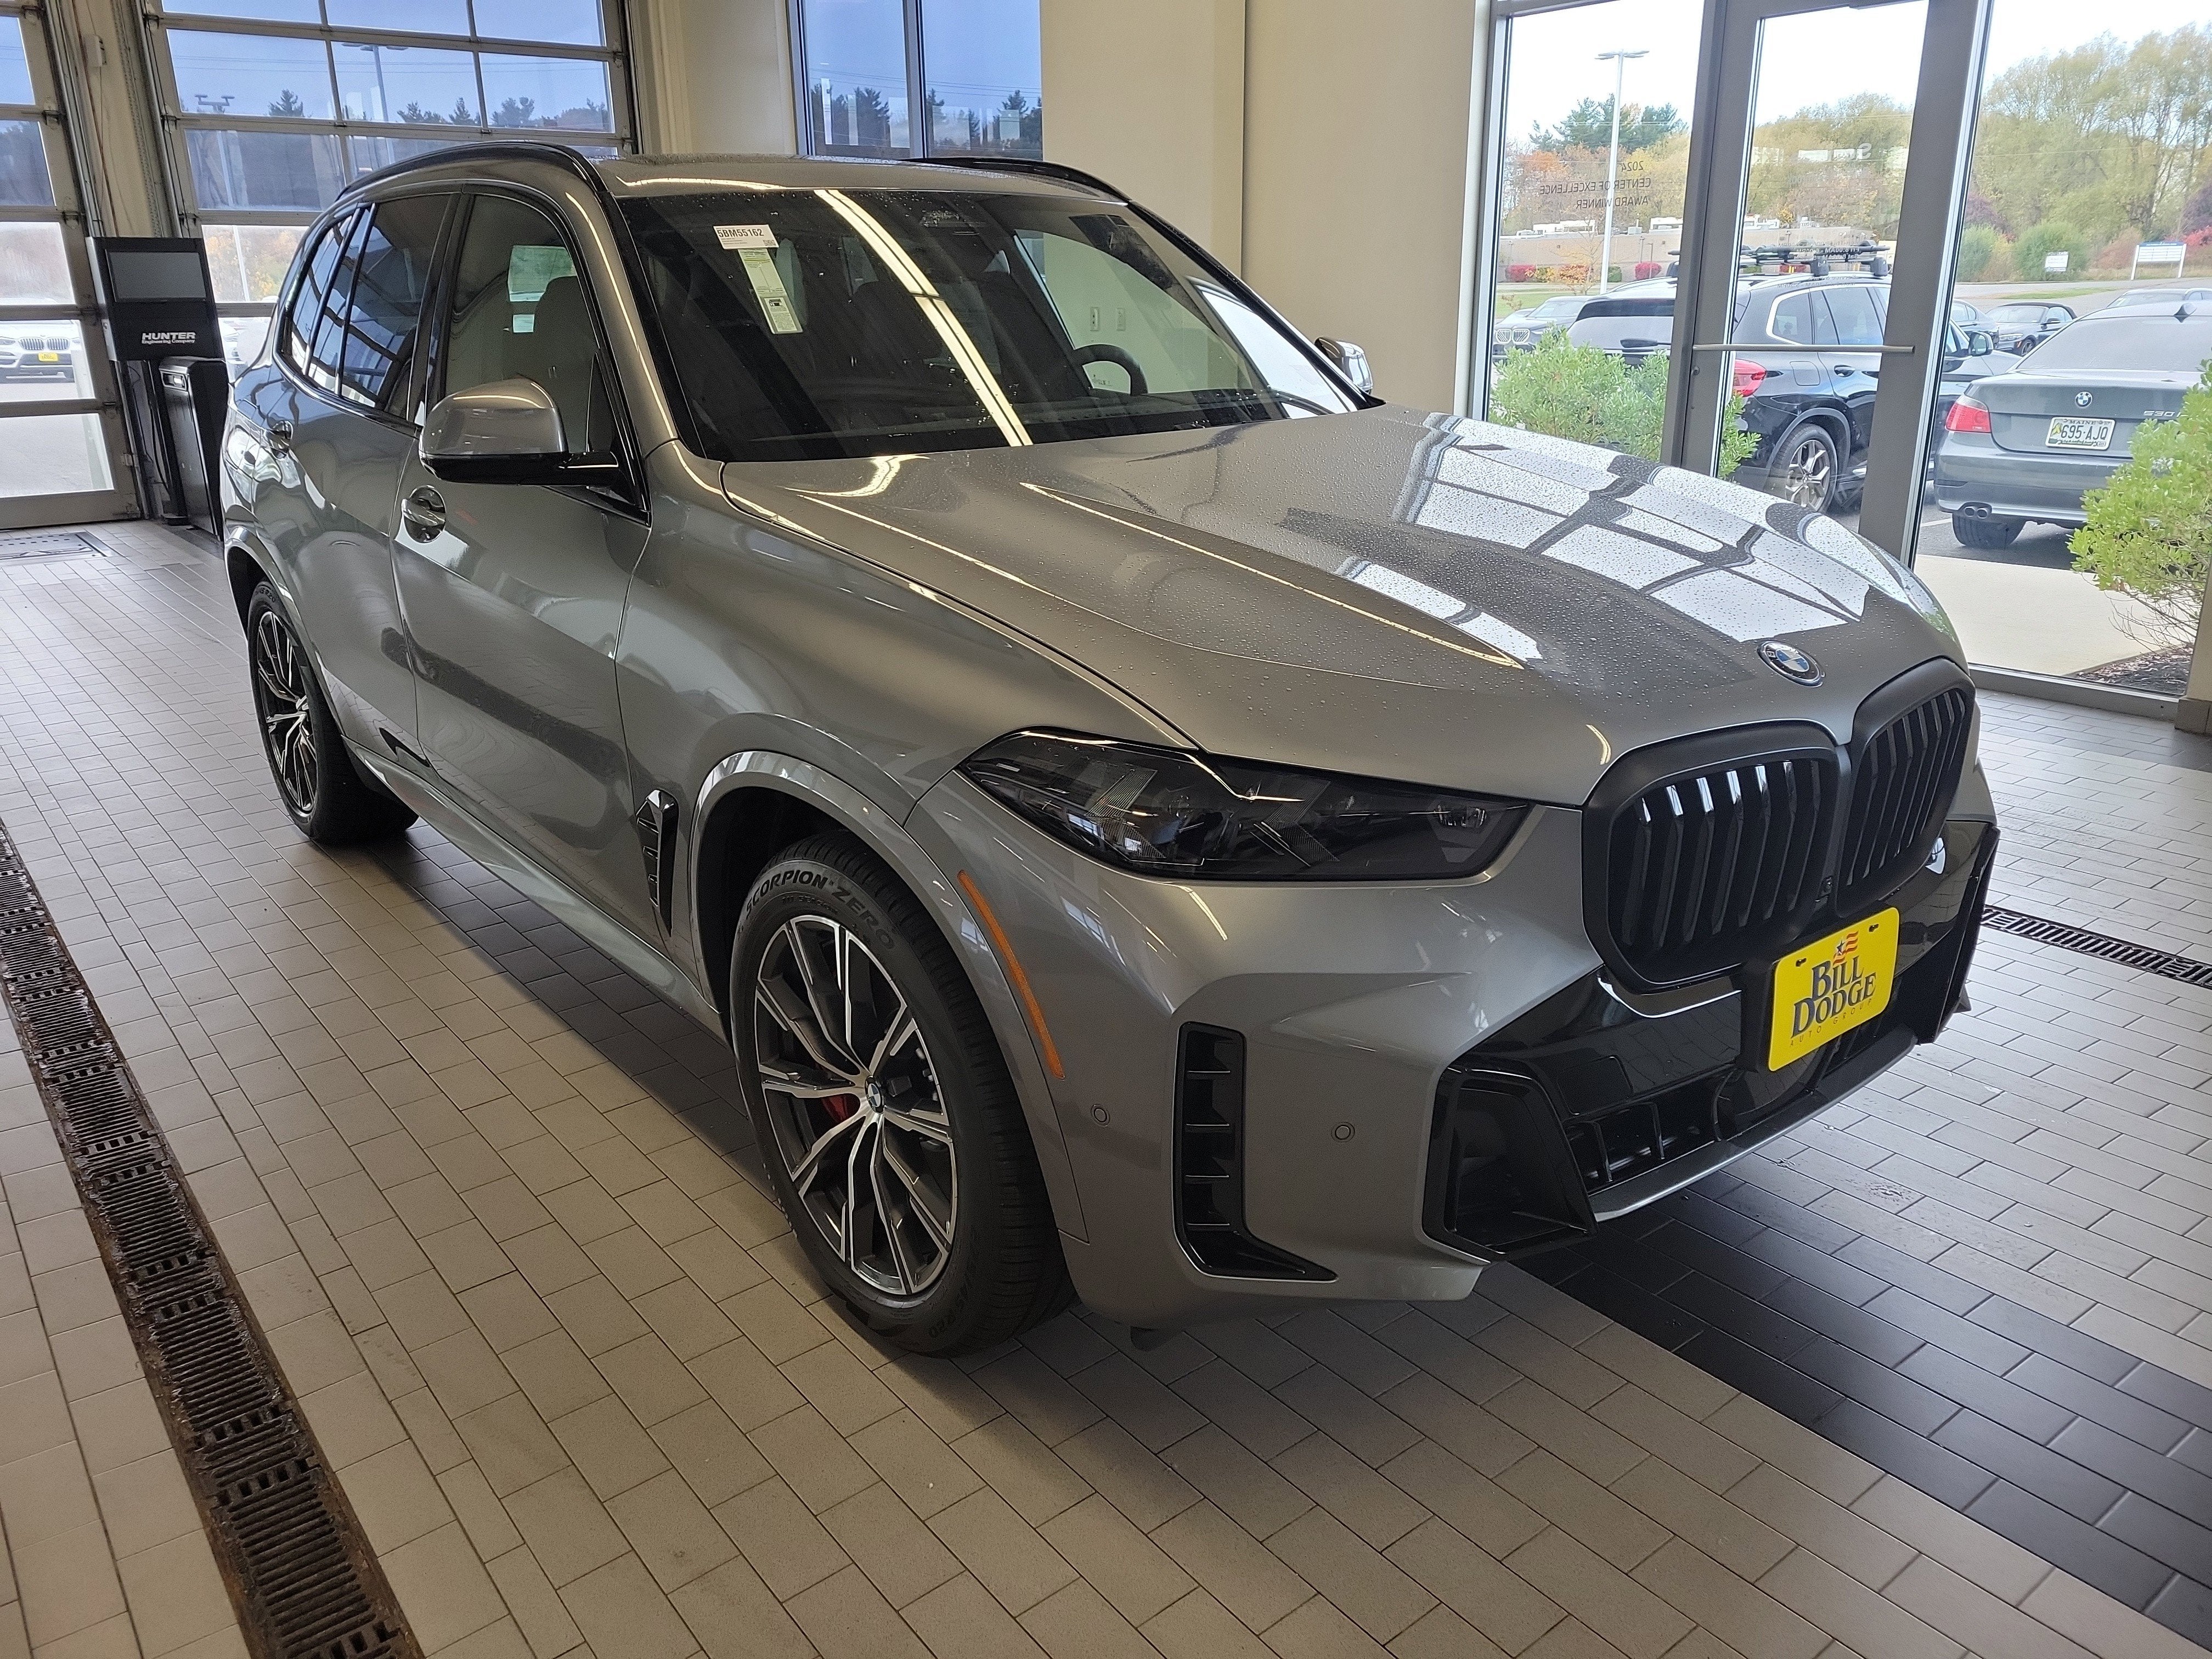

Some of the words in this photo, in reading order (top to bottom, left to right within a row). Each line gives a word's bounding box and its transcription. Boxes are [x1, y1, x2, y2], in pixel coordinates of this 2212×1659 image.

[716, 228, 764, 238] 5BM55162
[142, 332, 196, 340] HUNTER
[746, 869, 827, 920] SCORPION
[832, 886, 895, 950] ZERO
[1812, 955, 1864, 1000] BILL
[1790, 1025, 1822, 1047] AUTO
[1832, 998, 1872, 1025] GROUP
[1791, 972, 1877, 1039] DODGE
